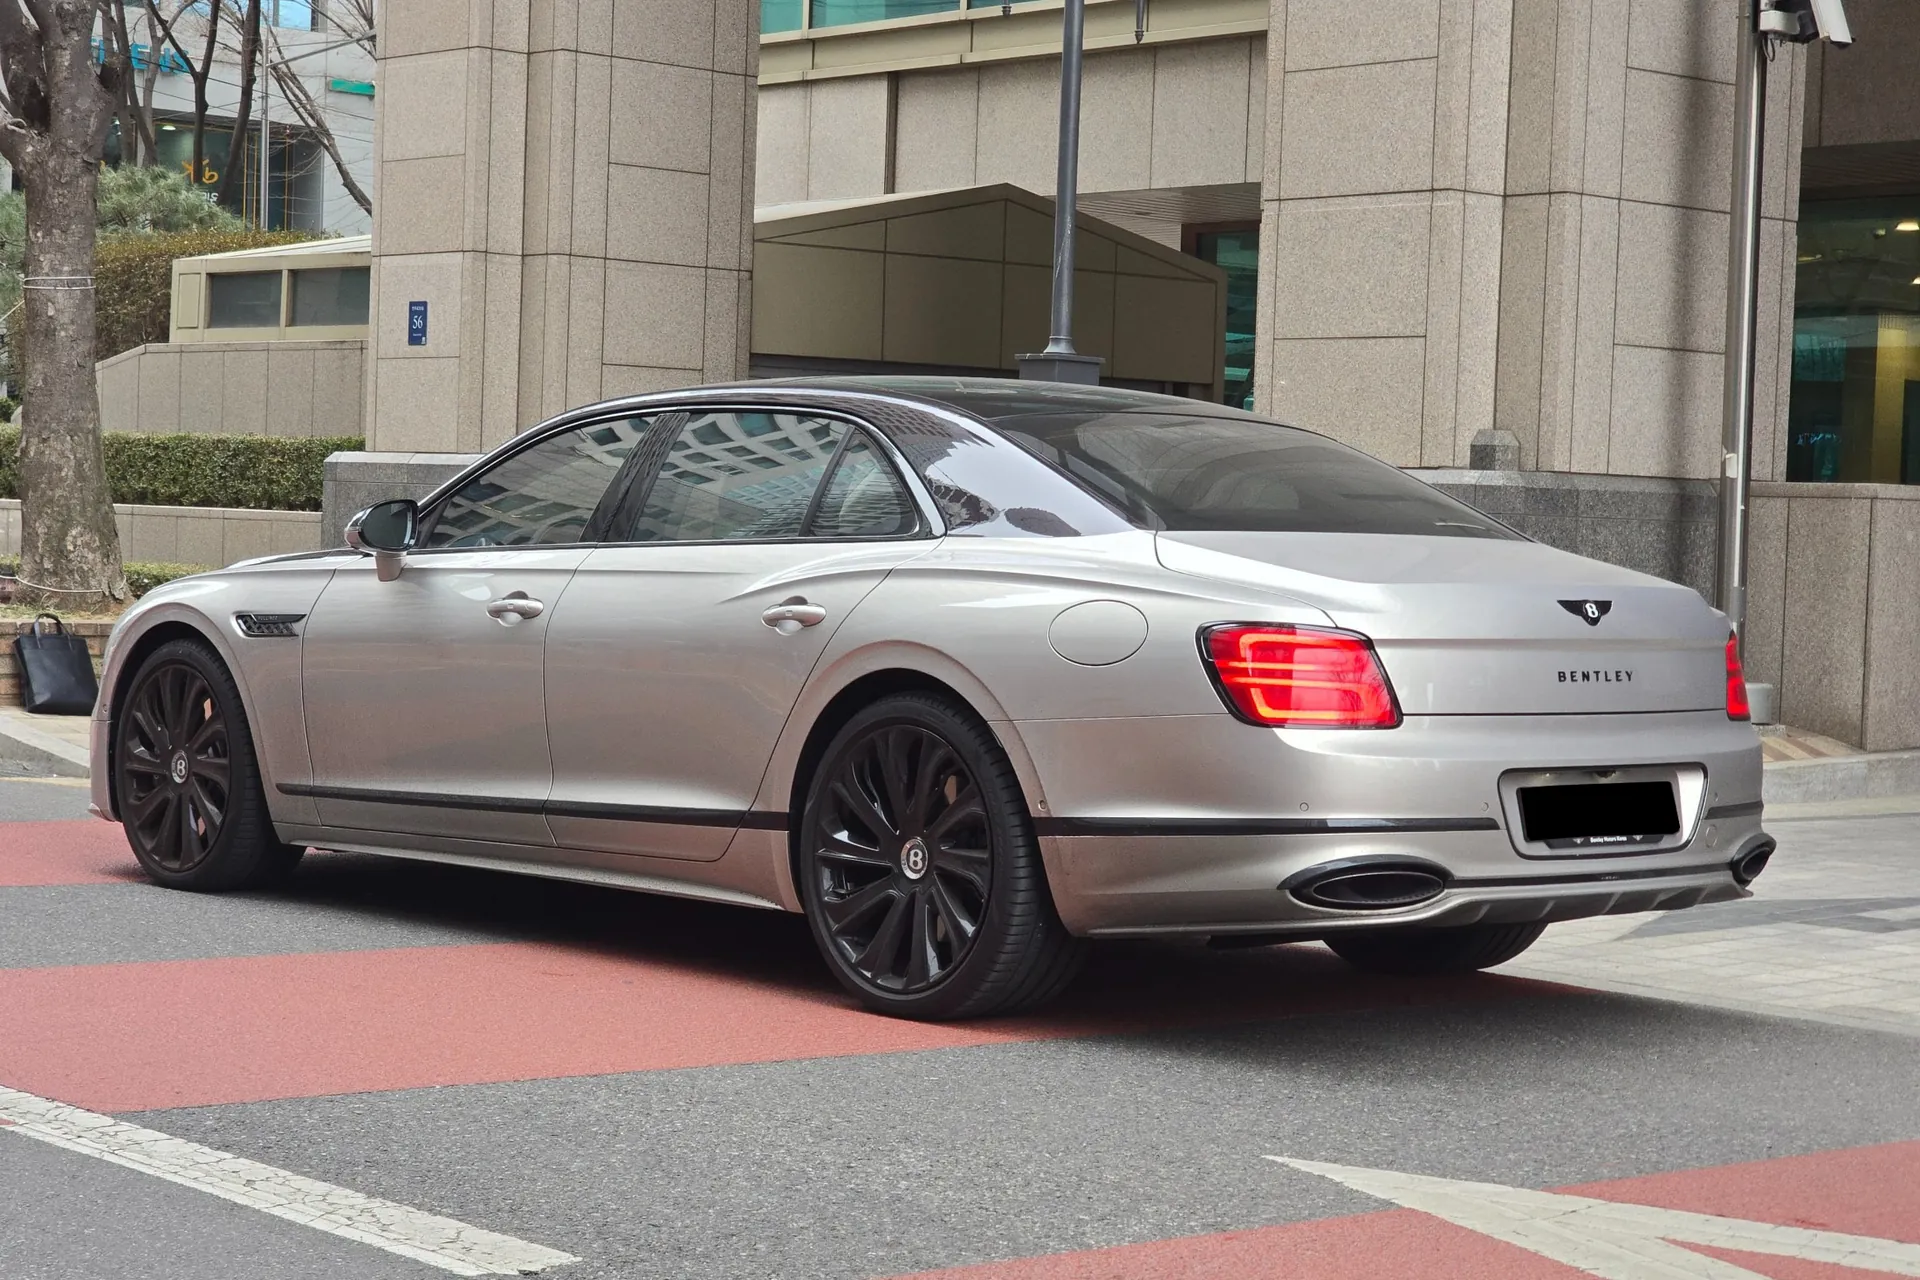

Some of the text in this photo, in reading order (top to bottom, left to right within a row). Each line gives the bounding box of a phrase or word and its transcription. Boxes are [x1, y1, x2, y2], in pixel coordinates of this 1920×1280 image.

[412, 315, 423, 329] 56
[1557, 670, 1633, 683] BENTLEY
[908, 848, 923, 870] B
